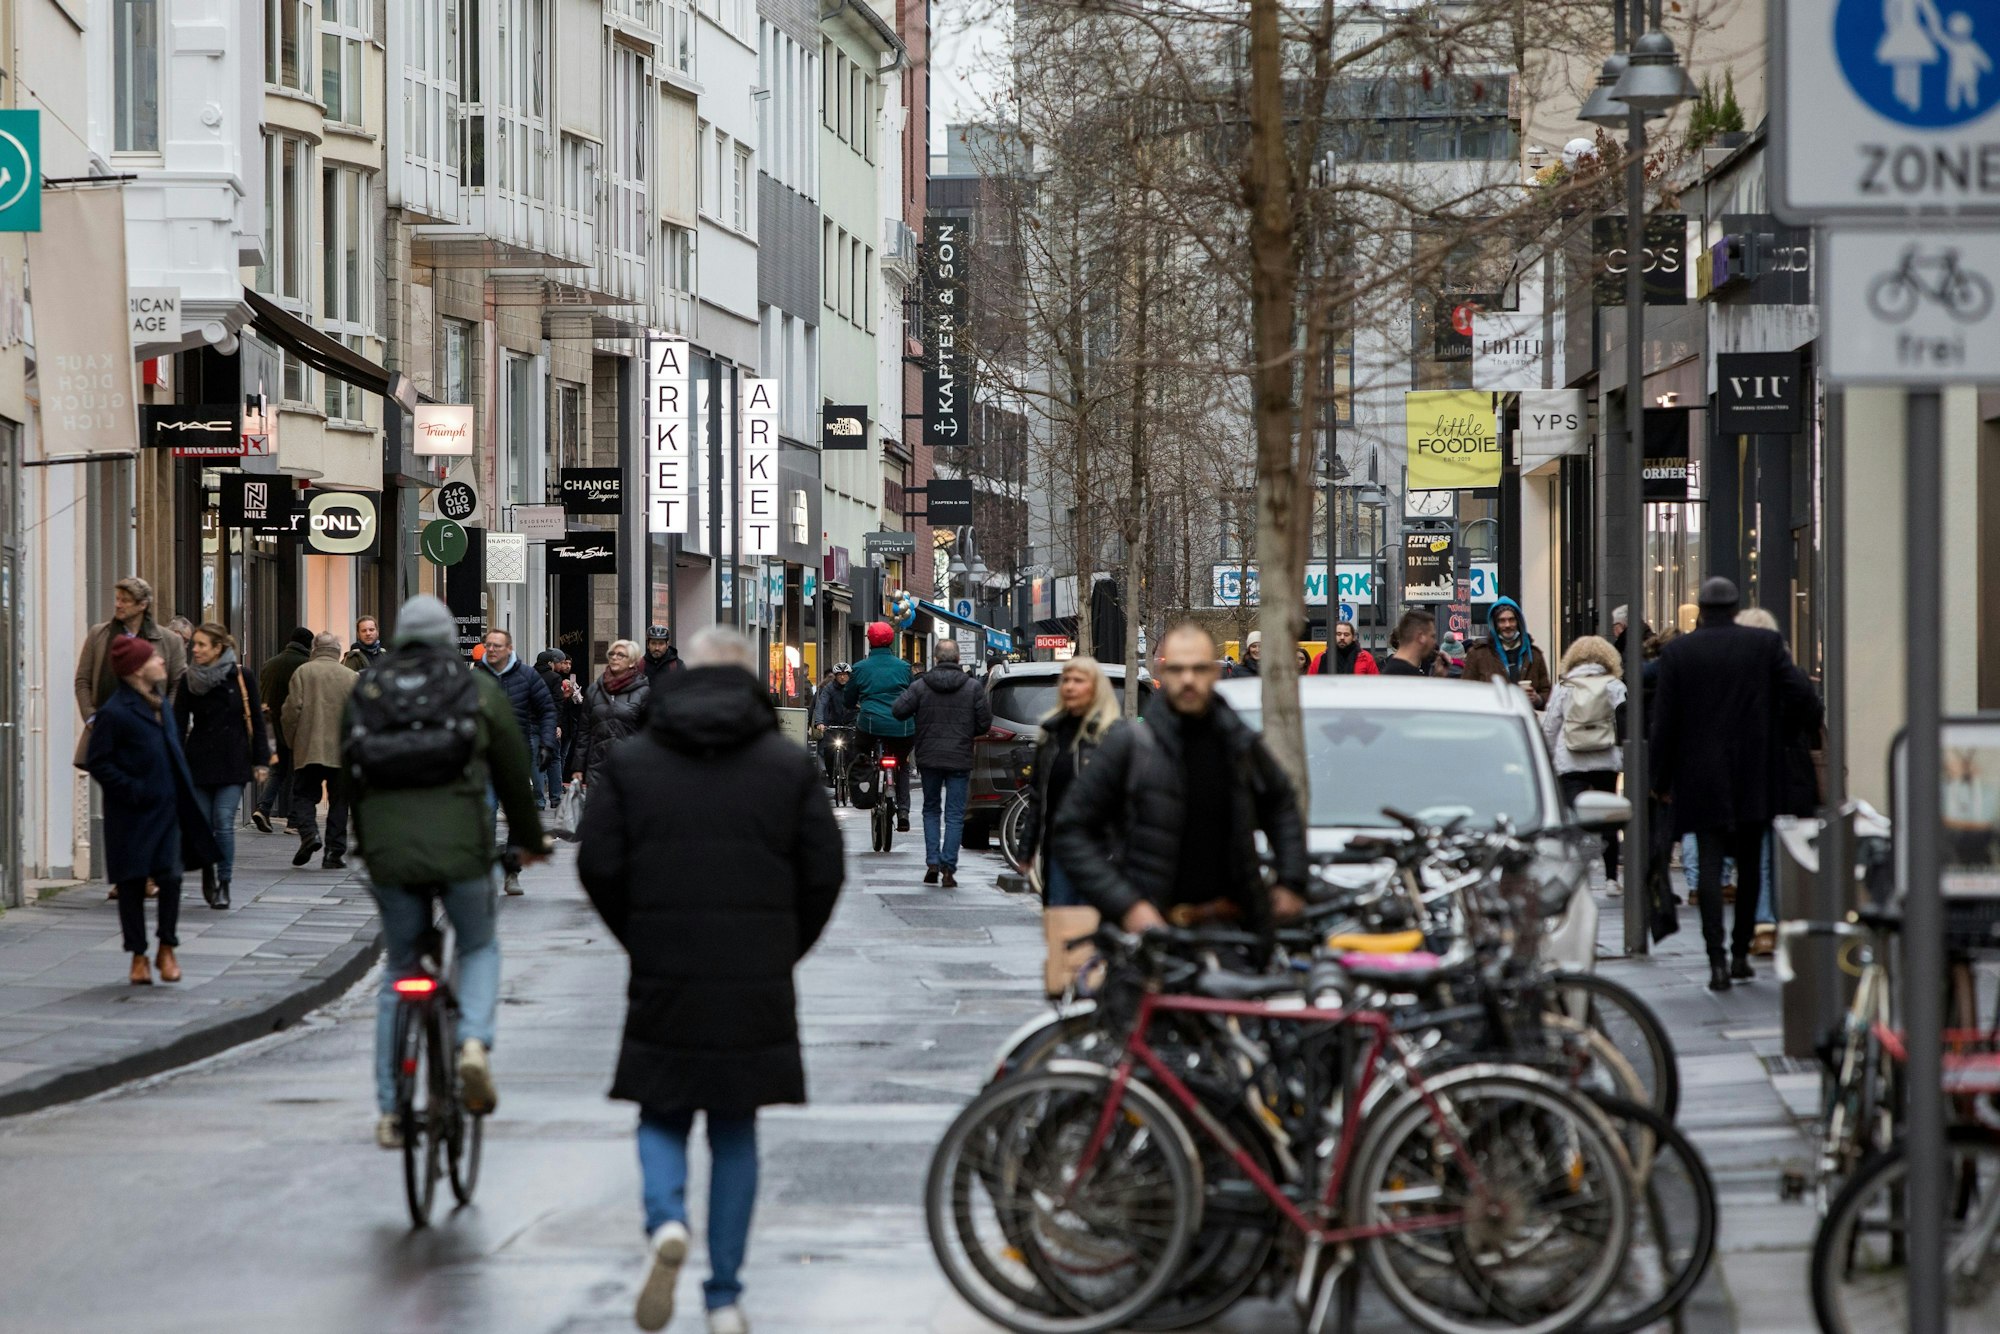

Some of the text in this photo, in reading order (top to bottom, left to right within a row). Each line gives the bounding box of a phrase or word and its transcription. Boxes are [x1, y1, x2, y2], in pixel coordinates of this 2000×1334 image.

[1858, 144, 2000, 193] ZONE
[939, 225, 953, 279] SON
[1483, 340, 1543, 354] EDITED
[939, 315, 953, 413] KAPTEN
[1730, 376, 1791, 398] VIU
[1426, 414, 1485, 443] little
[1533, 414, 1578, 430] YPS
[418, 423, 467, 442] Triumph
[657, 348, 681, 527] ARKET
[1418, 437, 1498, 454] FOODIE
[749, 384, 771, 550] ARKET
[1644, 457, 1687, 468] ELLOW
[1642, 467, 1688, 479] ORNER
[444, 487, 466, 498] 24C
[563, 480, 620, 490] CHANGE
[445, 496, 469, 507] OLO
[588, 491, 619, 502] Lingerie
[244, 511, 267, 519] NILE
[447, 504, 471, 516] URS
[311, 515, 371, 531] ONLY
[1408, 534, 1451, 543] FITNESS
[552, 545, 613, 560] Thomas Sabo
[1303, 572, 1371, 597] WRK
[1037, 637, 1067, 647] BÜCHER
[1363, 633, 1385, 641] WRK
